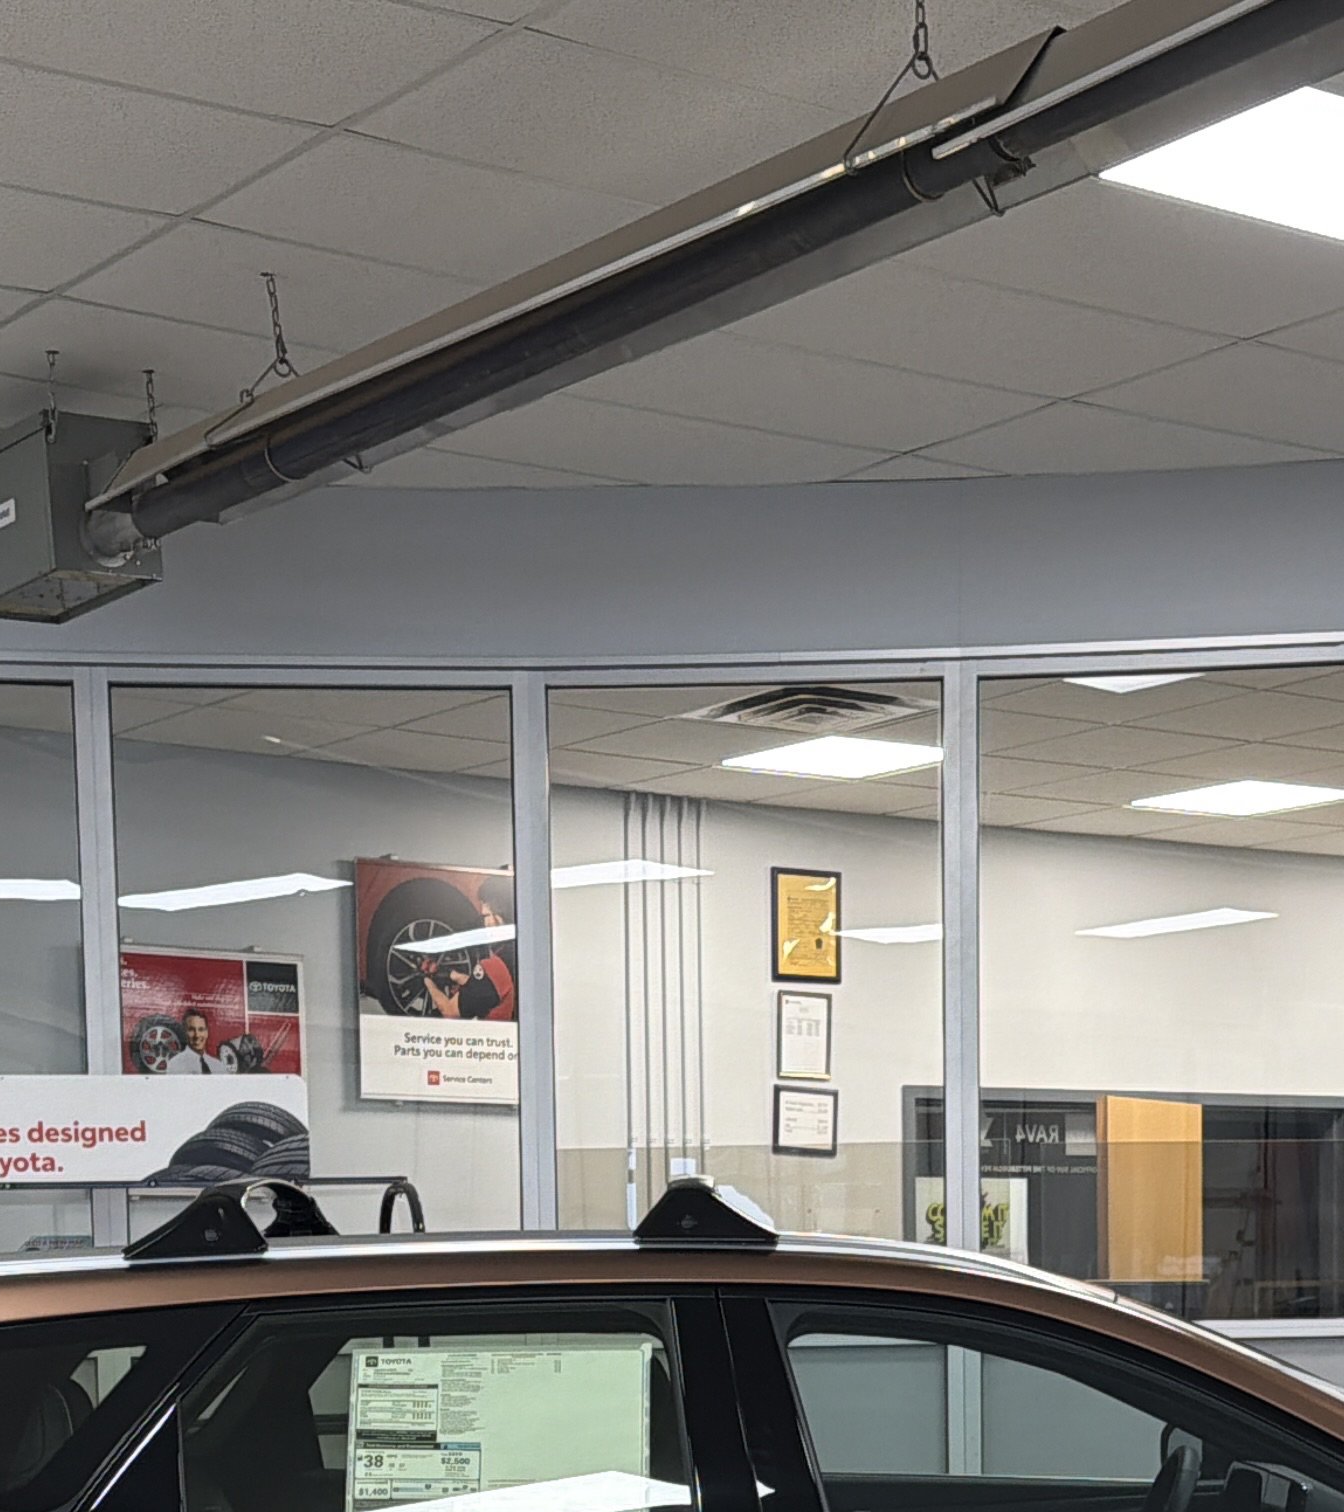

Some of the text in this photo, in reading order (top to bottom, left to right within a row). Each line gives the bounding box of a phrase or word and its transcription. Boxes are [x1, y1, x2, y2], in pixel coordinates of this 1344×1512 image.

[263, 982, 296, 993] TOYOTA
[404, 1032, 513, 1048] Service you can trust.
[394, 1045, 421, 1057] Parts
[423, 1048, 442, 1059] you
[445, 1049, 463, 1058] can
[466, 1049, 505, 1061] depend
[443, 1075, 466, 1084] Service
[27, 1120, 146, 1148] designed
[380, 1358, 412, 1366] TOYOTA
[363, 1454, 384, 1468] 38
[440, 1457, 471, 1466] $2,500
[358, 1487, 389, 1497] $1,400
